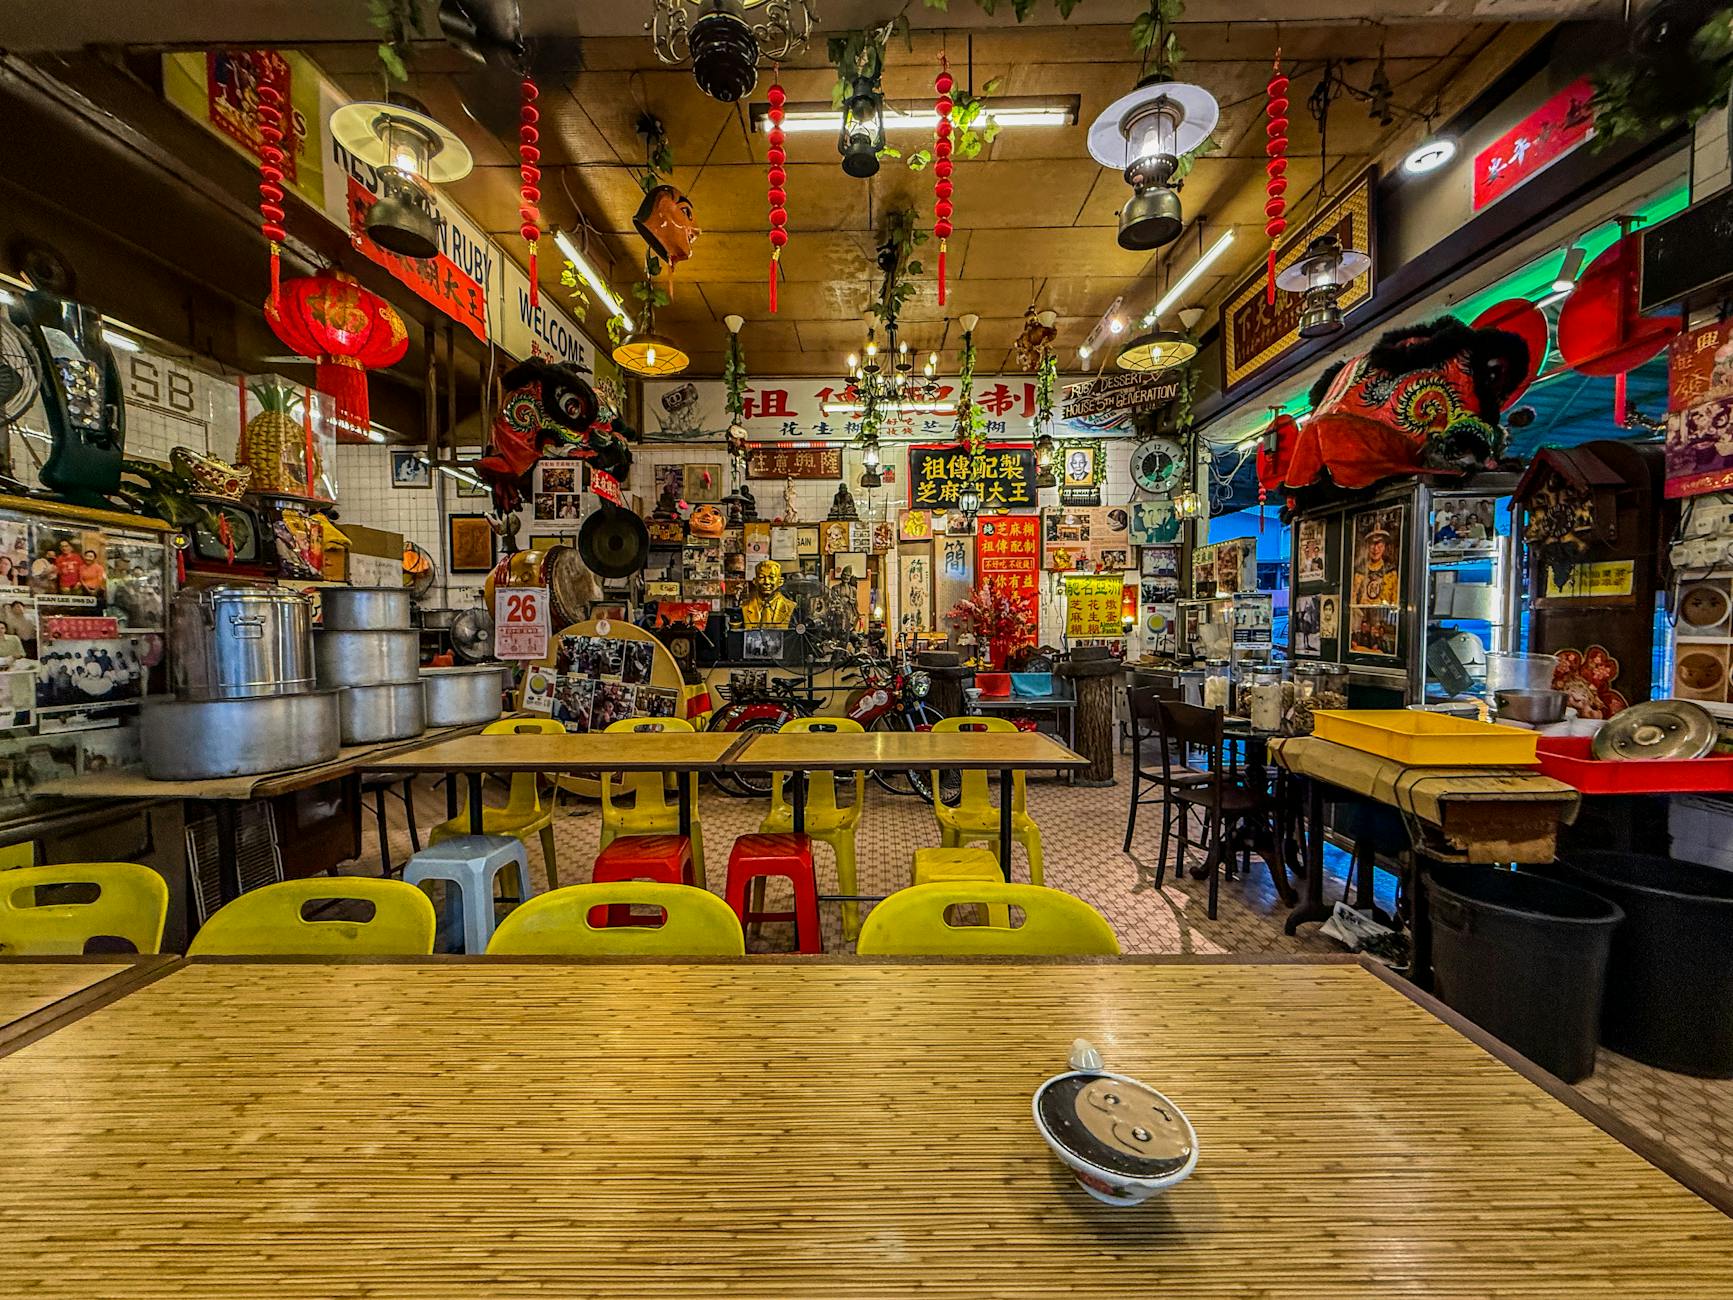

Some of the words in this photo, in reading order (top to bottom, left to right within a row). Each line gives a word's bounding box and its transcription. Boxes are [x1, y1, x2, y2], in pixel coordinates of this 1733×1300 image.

[453, 223, 491, 284] RUBY
[519, 286, 584, 363] WELCOME
[1070, 380, 1097, 399] RUBY
[1100, 372, 1143, 393] DESSERT
[1065, 399, 1096, 419] HOUSE
[1096, 396, 1116, 412] 5TH
[1115, 382, 1178, 408] GENERATION
[920, 420, 1006, 435] 芝糊
[921, 454, 1025, 481] 祖傳配製
[507, 594, 537, 622] 26
